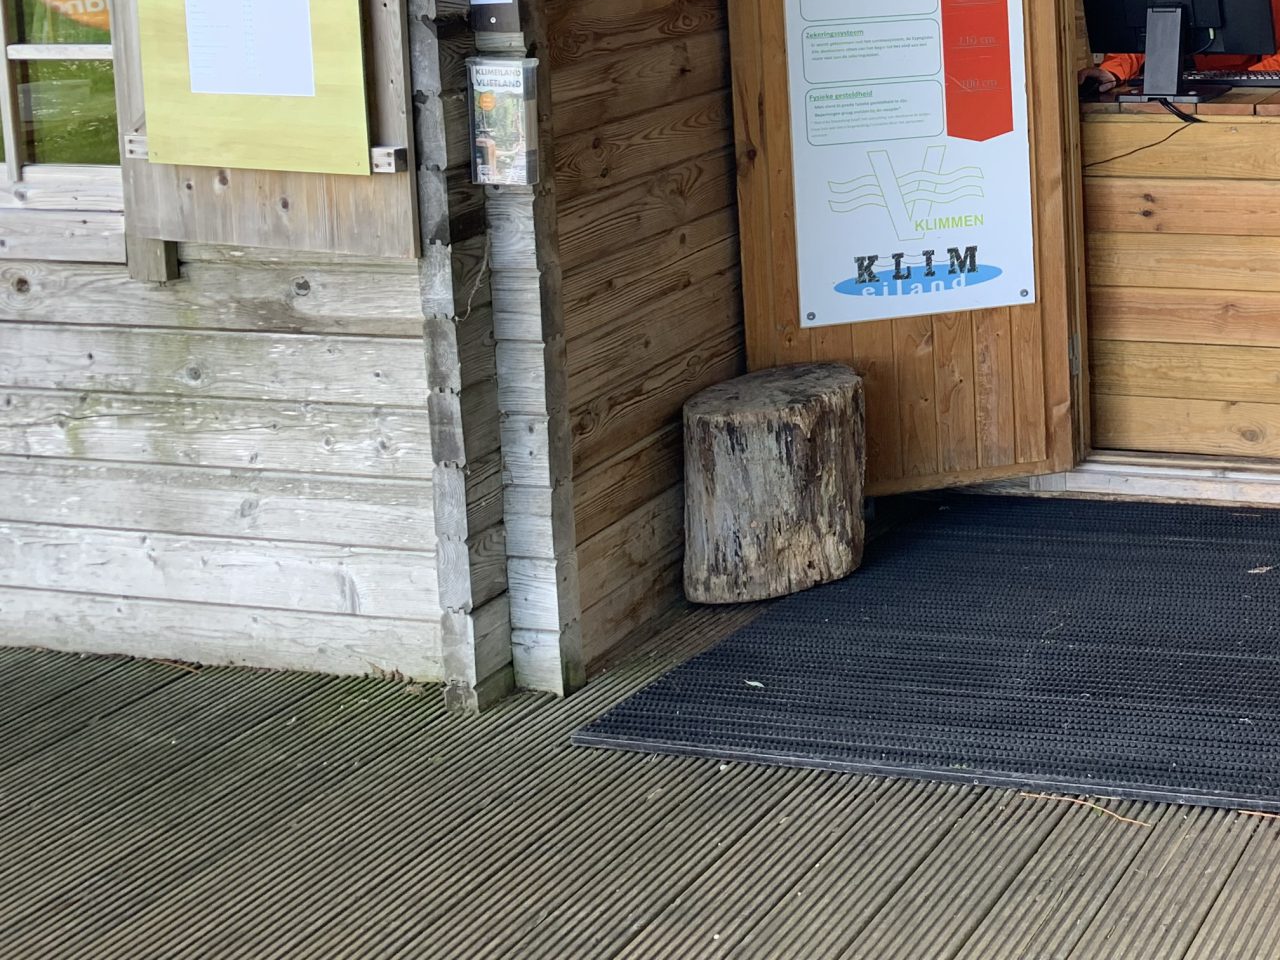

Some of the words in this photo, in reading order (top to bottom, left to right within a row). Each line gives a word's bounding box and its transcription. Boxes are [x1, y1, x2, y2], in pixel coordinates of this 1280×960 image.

[809, 94, 834, 103] Fysieke
[834, 91, 873, 101] gesteldheid
[914, 214, 985, 232] KLIMMEN
[853, 245, 979, 285] KLIM
[862, 272, 967, 297] eiland
